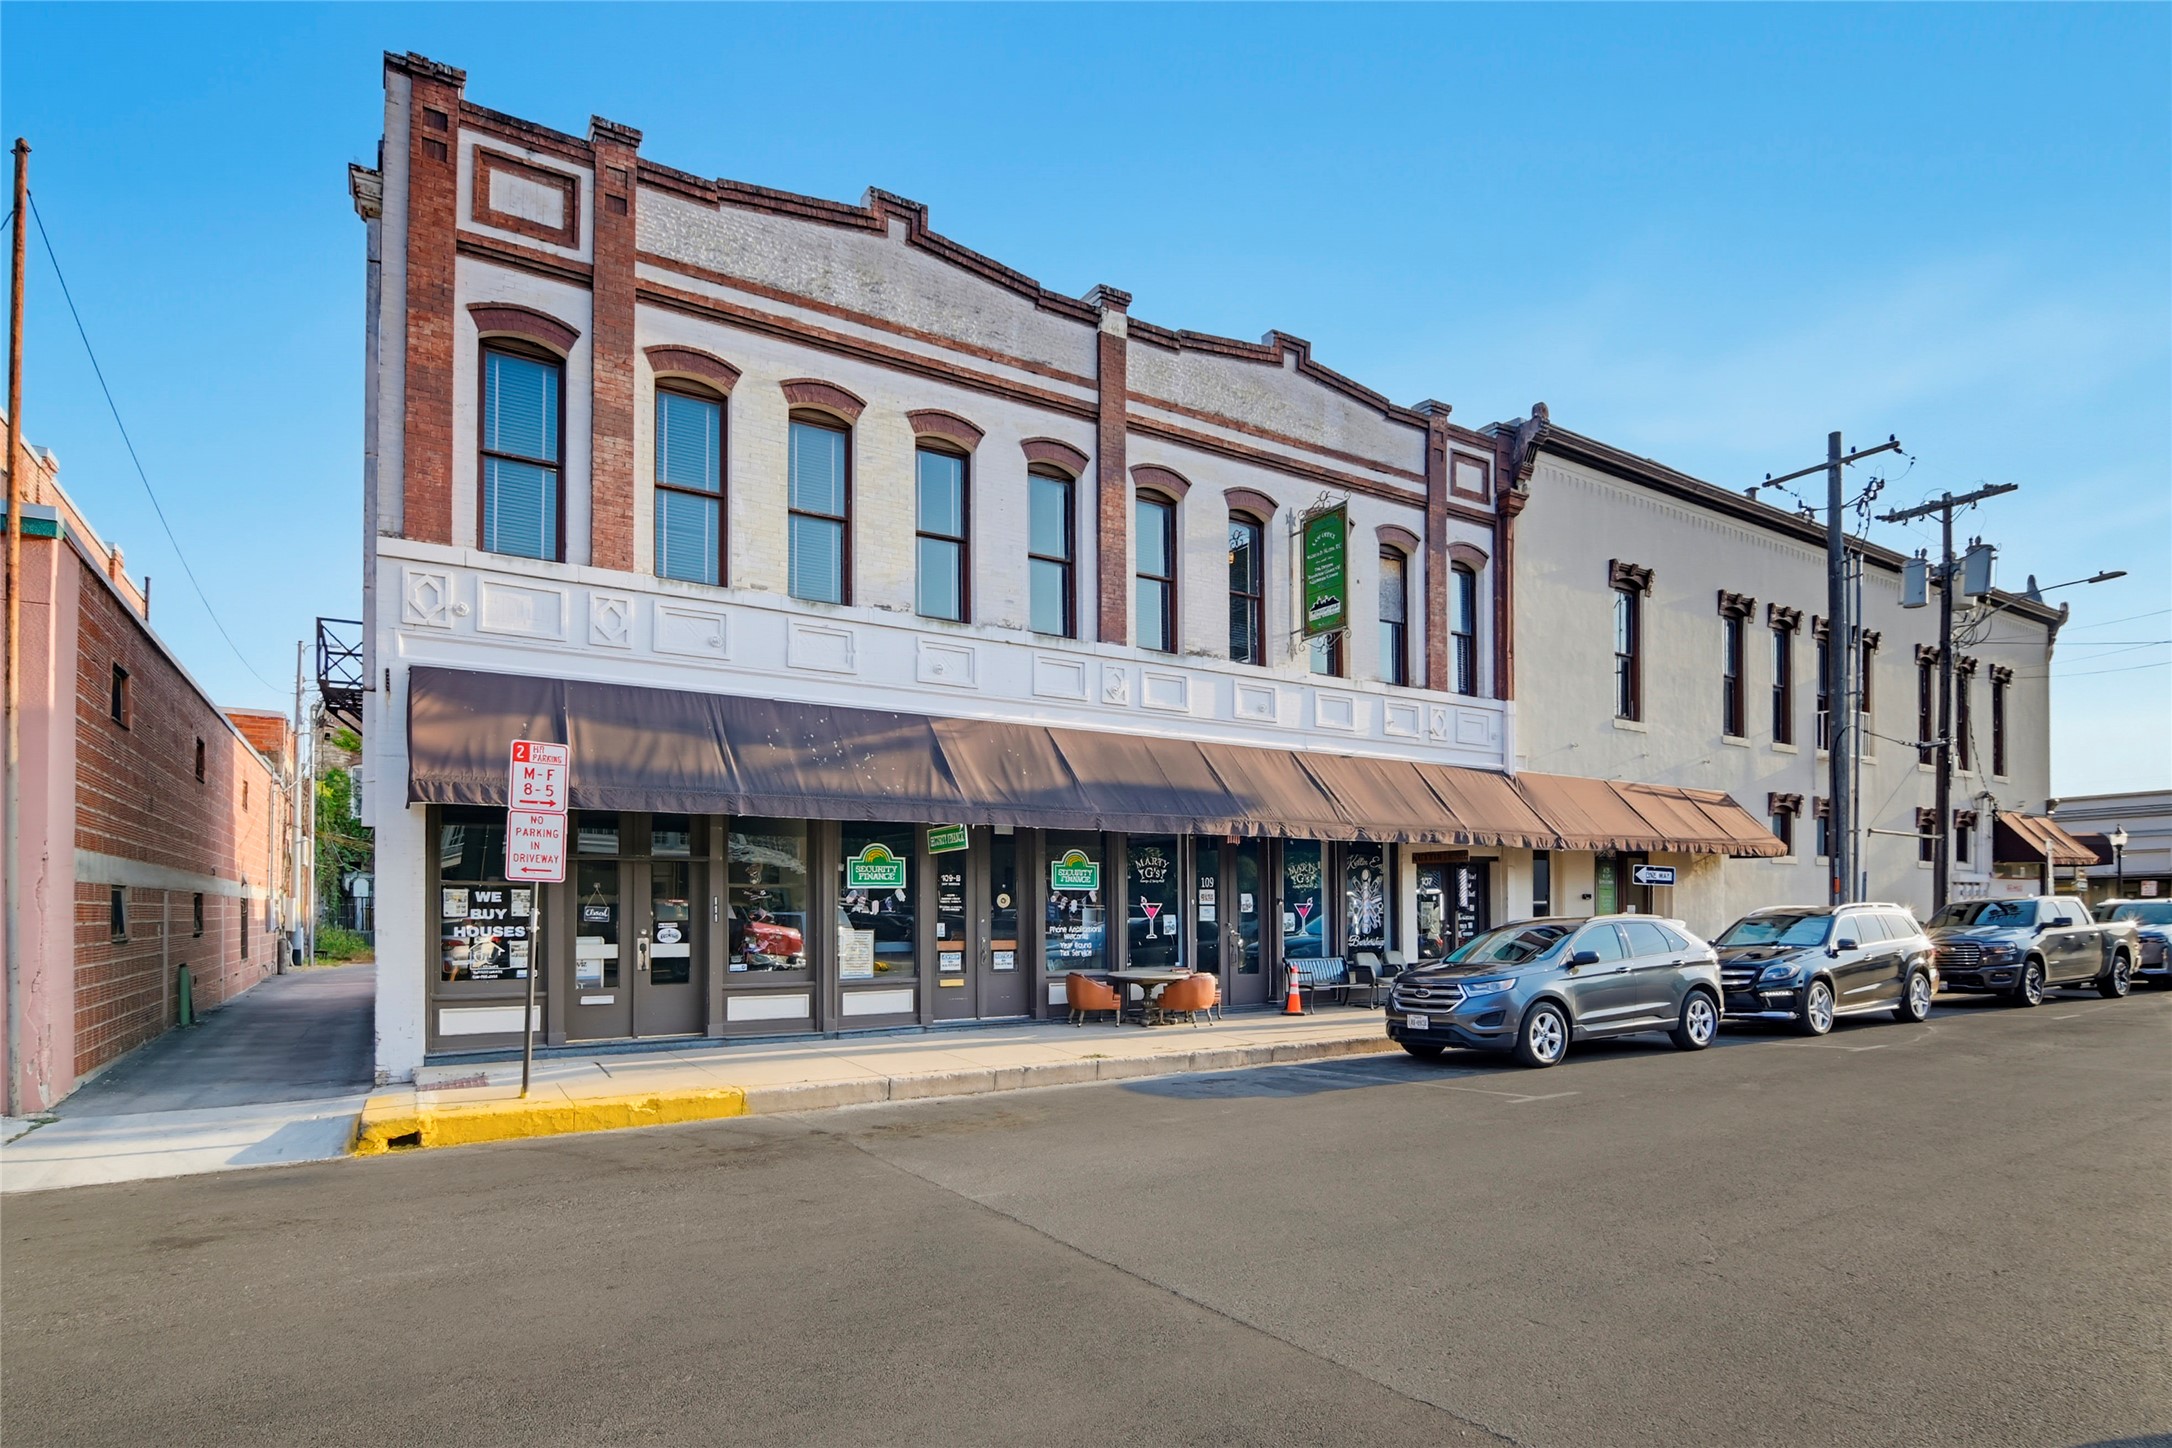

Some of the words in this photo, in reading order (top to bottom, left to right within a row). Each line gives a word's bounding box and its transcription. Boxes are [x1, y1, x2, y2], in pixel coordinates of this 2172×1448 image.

[516, 745, 525, 758] 2
[533, 745, 545, 754] HR
[532, 754, 562, 764] PARKING
[530, 815, 544, 825] NO
[515, 827, 559, 839] PARKING
[530, 841, 540, 850] IN
[513, 853, 559, 864] DRIVEWAY
[1135, 857, 1170, 868] MARTY
[855, 865, 898, 873] SECURITY
[1057, 868, 1093, 876] SECURITY
[1145, 867, 1161, 878] G's
[858, 872, 896, 880] FINANCE
[1060, 875, 1092, 883] FINANCE
[1646, 871, 1657, 879] ONE
[1201, 876, 1214, 888] 109
[475, 891, 503, 903] WE
[470, 908, 508, 920] BUY
[453, 925, 527, 938] HOUSES
